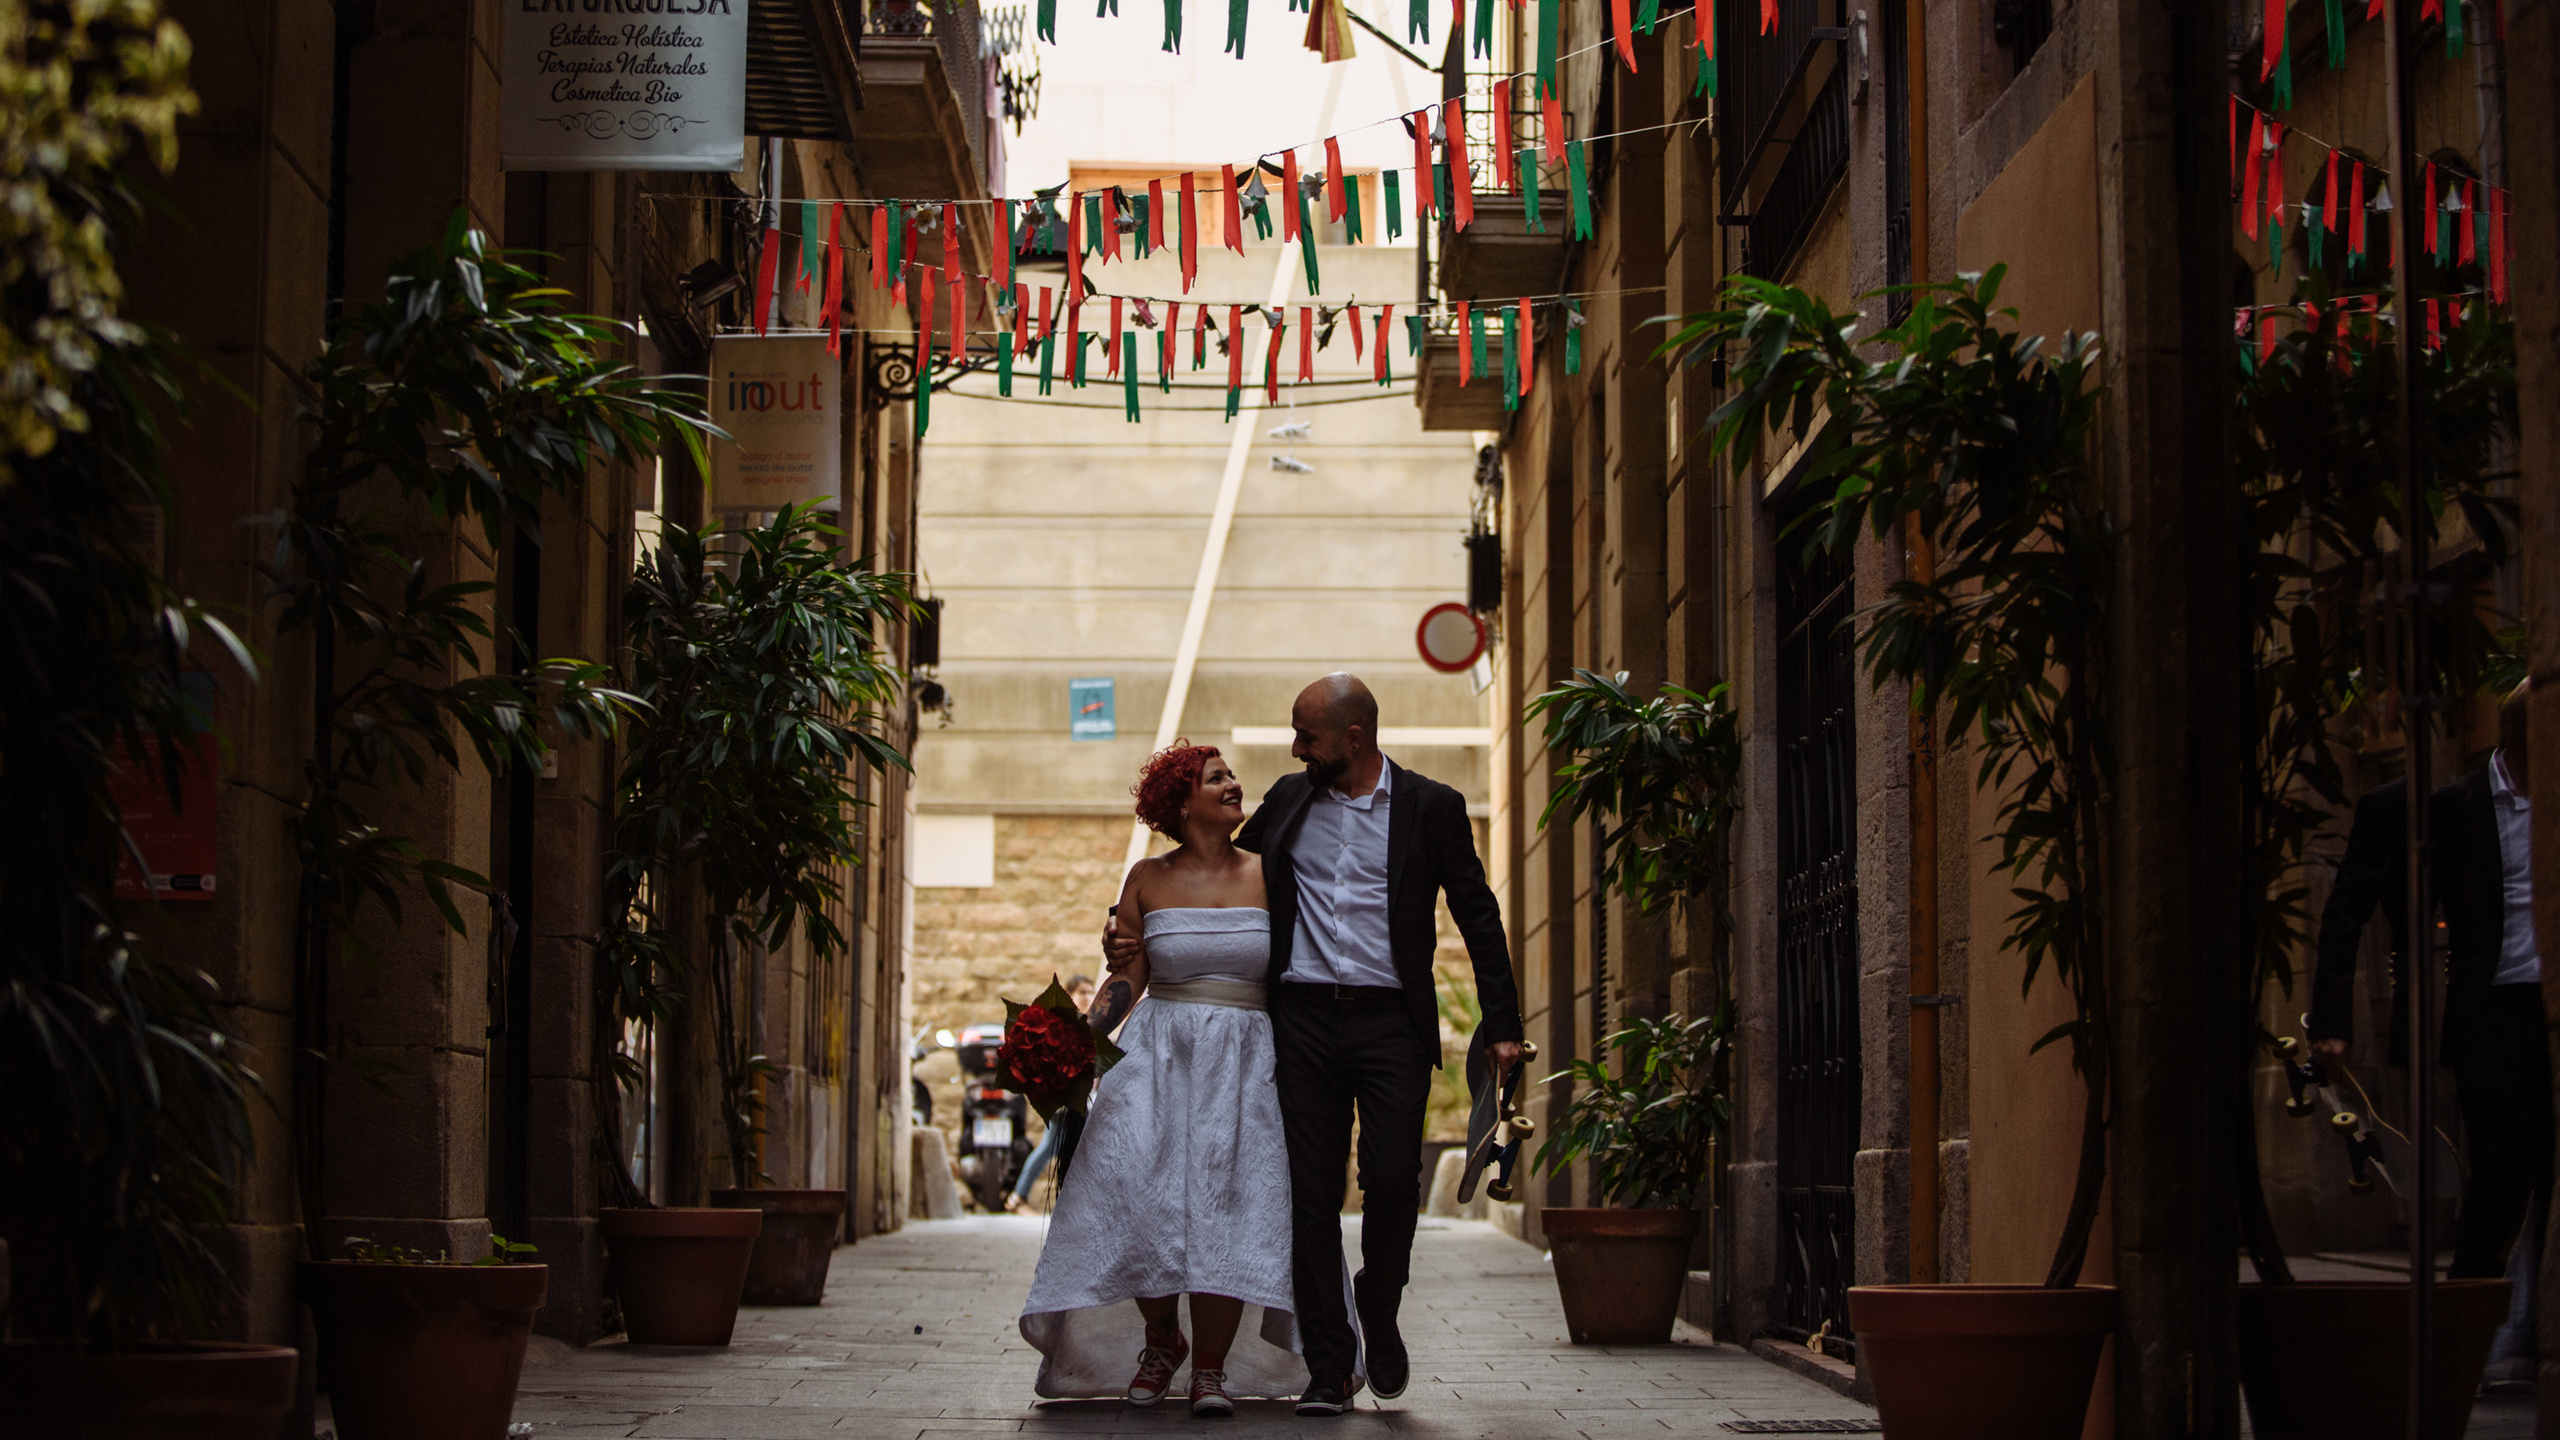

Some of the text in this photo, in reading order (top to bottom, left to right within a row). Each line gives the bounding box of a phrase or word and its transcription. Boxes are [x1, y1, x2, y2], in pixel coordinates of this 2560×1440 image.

[550, 23, 704, 49] Estetica Holística
[537, 50, 708, 84] Terapias Naturales
[551, 78, 683, 104] Cosmetica Bio
[740, 452, 773, 462] botiga
[739, 463, 814, 472] tienda de autor
[743, 474, 810, 486] designer shop
